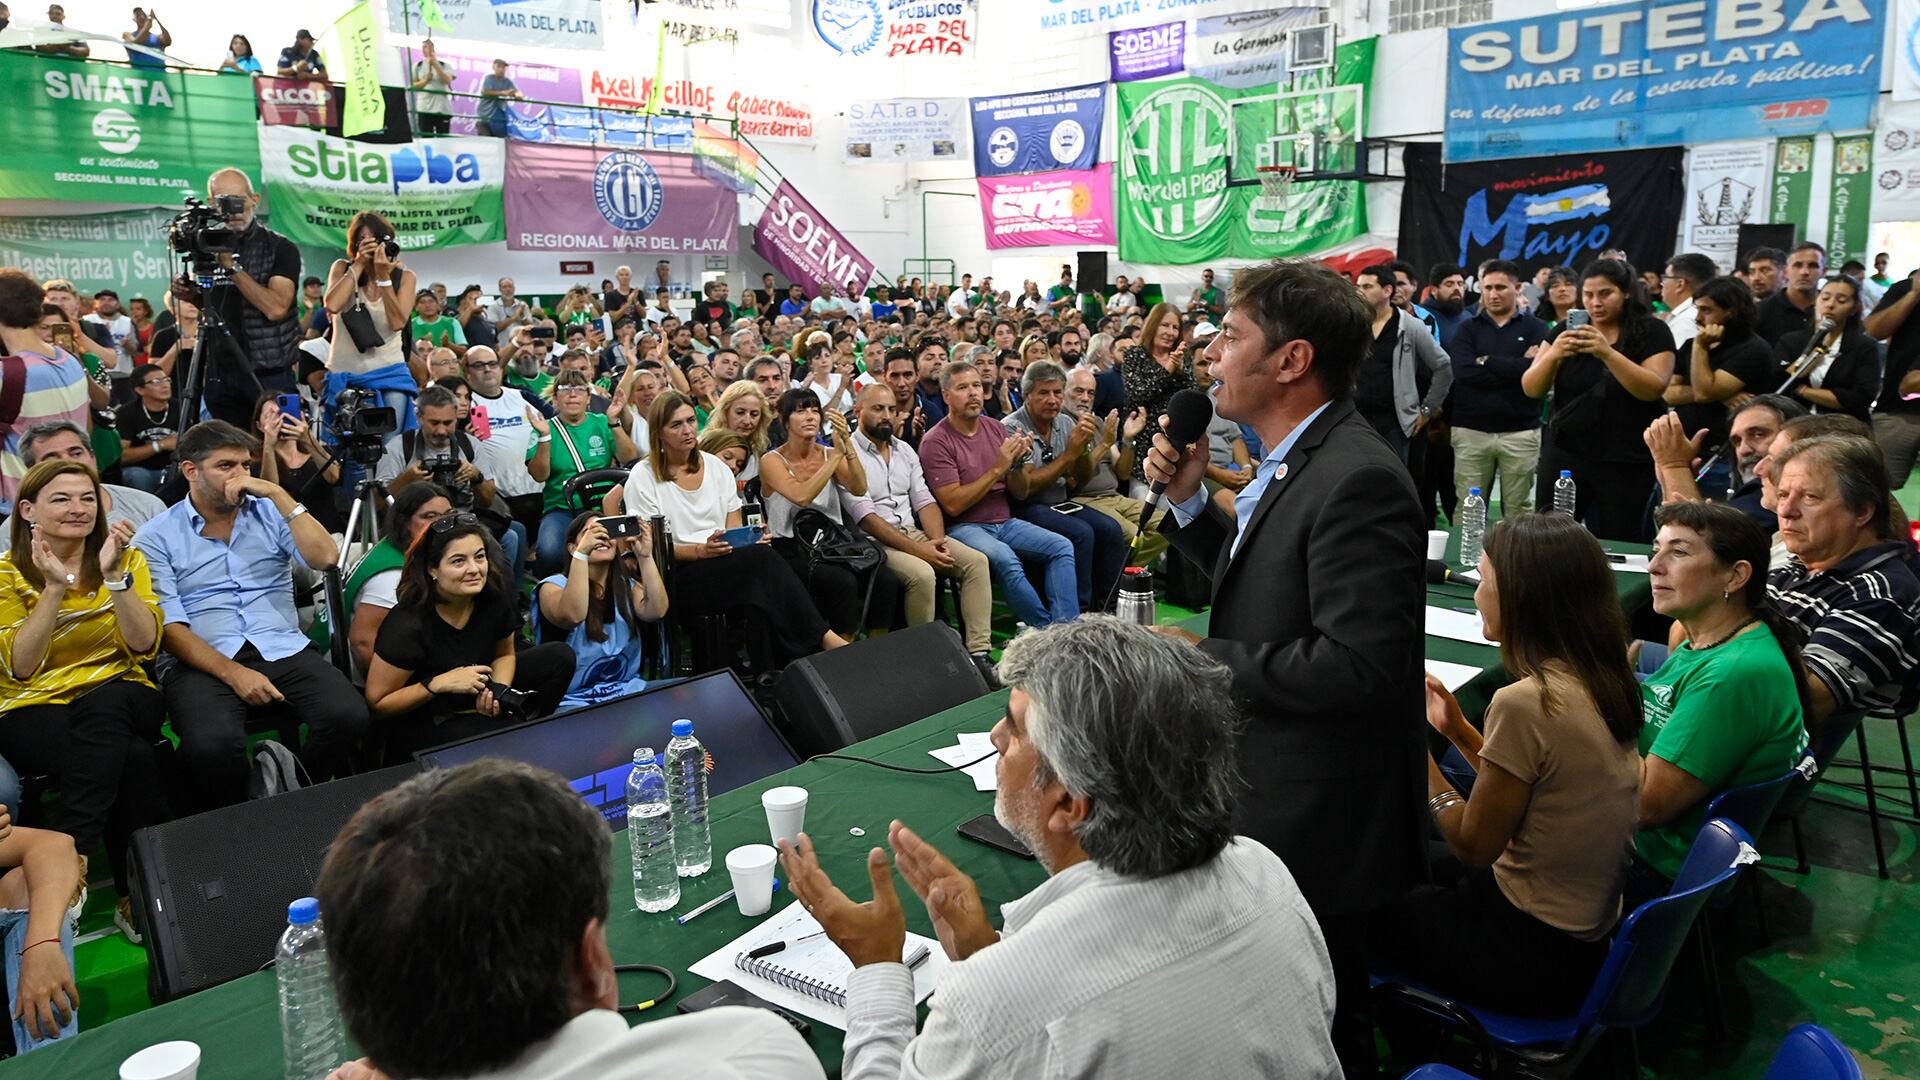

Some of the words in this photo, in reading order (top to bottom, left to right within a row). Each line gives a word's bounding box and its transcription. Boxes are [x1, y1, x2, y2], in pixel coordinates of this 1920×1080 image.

[495, 11, 527, 29] MAR
[531, 15, 555, 31] DEL
[559, 18, 598, 35] PLATA
[888, 22, 927, 42] MAR
[938, 19, 970, 41] DEL
[1040, 12, 1067, 29] MAR
[1071, 8, 1095, 25] DEL
[1099, 1, 1141, 22] PLATA
[886, 36, 964, 58] PLATA
[1113, 23, 1183, 55] SOEME
[1213, 40, 1229, 55] La
[1460, 0, 1872, 73] SUTEBA
[1506, 66, 1582, 90] MAR
[1592, 58, 1664, 81] DEL
[1675, 41, 1801, 72] PLATA
[44, 70, 175, 109] SMATA
[591, 70, 636, 98] Axel
[642, 76, 716, 113] Kcillof
[1448, 106, 1475, 119] en
[1481, 101, 1563, 122] defensa
[1571, 92, 1602, 113] de
[1610, 87, 1637, 108] la
[1645, 67, 1738, 100] escuela
[1762, 98, 1829, 121] CTA
[98, 156, 159, 170] sentimiento
[287, 140, 480, 196] stiapba
[1494, 160, 1605, 191] movimiento
[54, 172, 113, 184] SECCIONAL
[115, 174, 137, 186] MAR
[139, 175, 158, 187] DEL
[159, 177, 190, 189] PLATA
[318, 205, 398, 218] AGRUPÓN
[401, 210, 433, 218] LISTA
[436, 207, 474, 217] VERDE
[1774, 176, 1792, 223] PASTE
[37, 218, 110, 241] Gremial
[391, 222, 419, 231] MAR
[422, 222, 445, 232] DEL
[448, 215, 483, 228] PLATA
[1458, 187, 1611, 269] Mayo
[1829, 177, 1851, 269] PASTELEROS
[521, 233, 608, 248] REGIONAL
[613, 235, 647, 249] MAR
[651, 237, 680, 250] DEL
[683, 237, 728, 251] PLATA
[771, 195, 866, 288] SOEME
[773, 238, 810, 272] MINORIDAD
[3, 250, 113, 281] Maestranza
[119, 256, 130, 287] y
